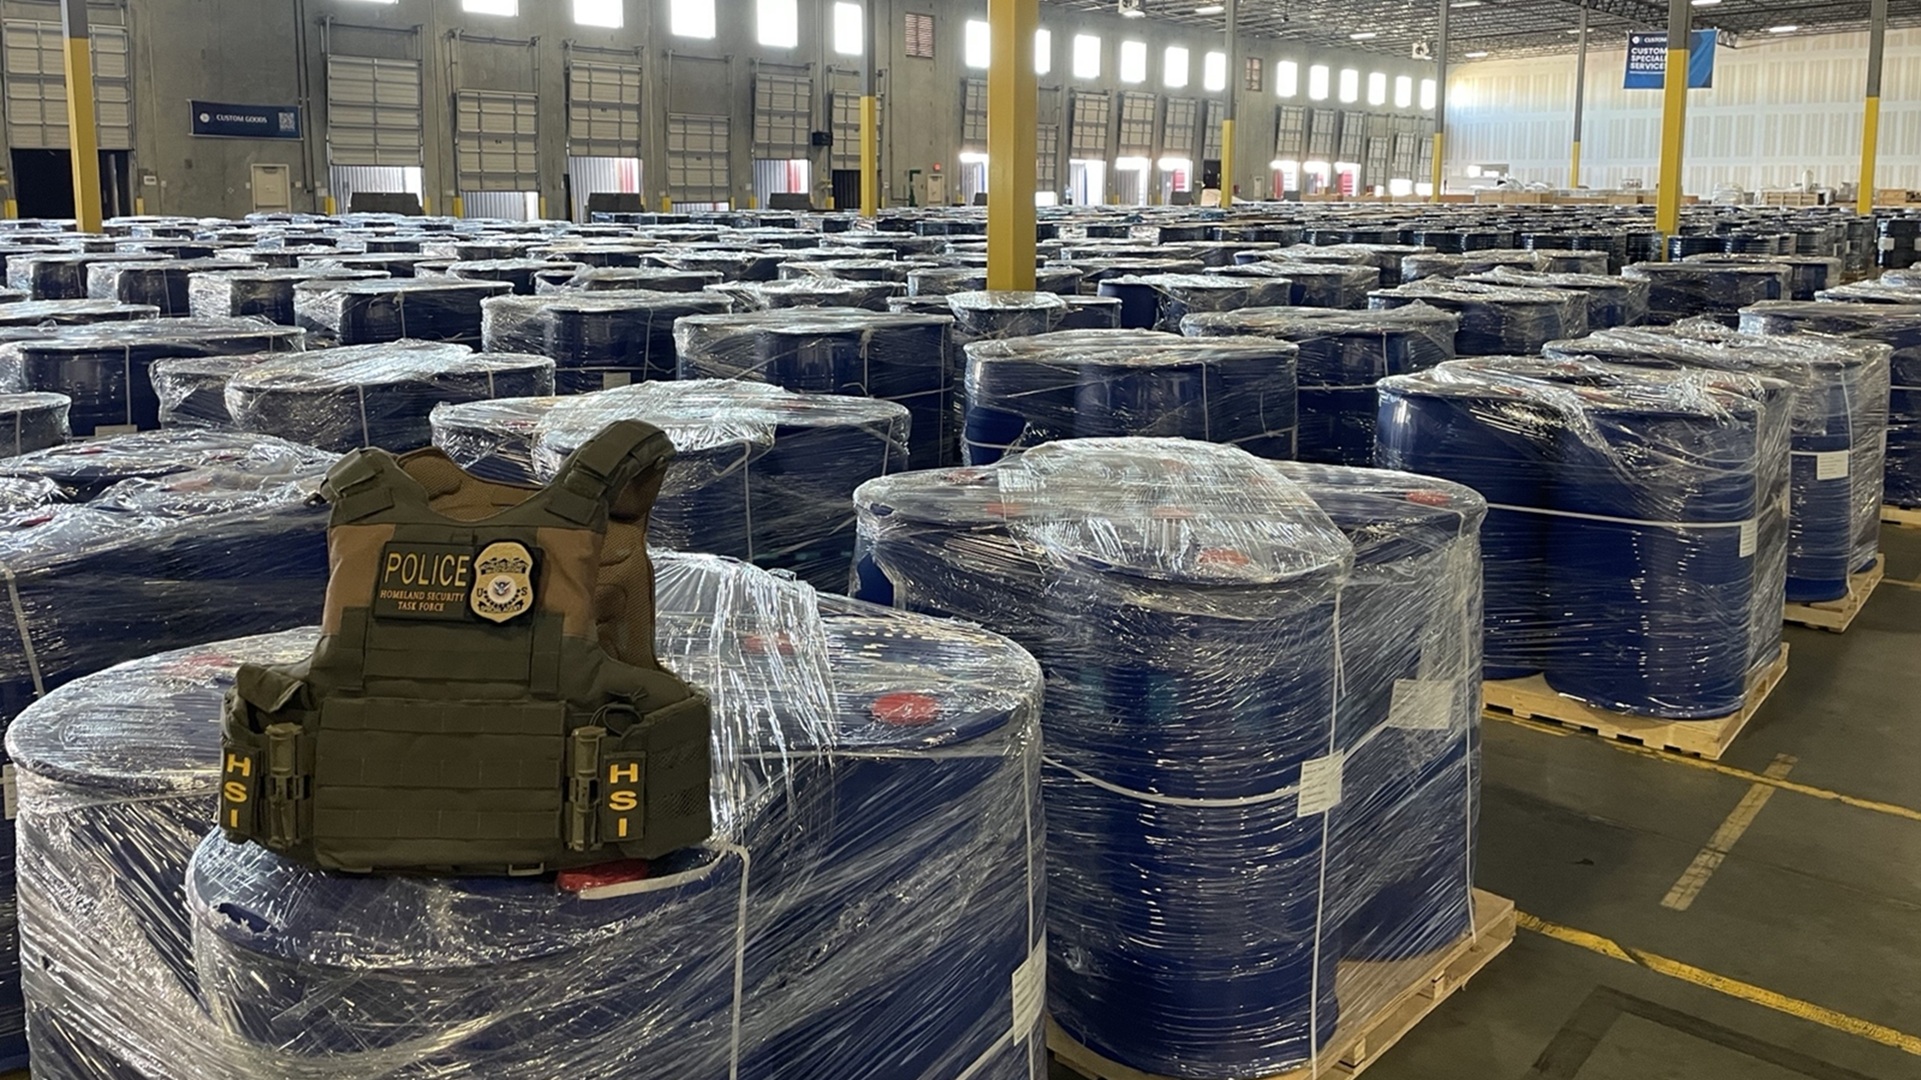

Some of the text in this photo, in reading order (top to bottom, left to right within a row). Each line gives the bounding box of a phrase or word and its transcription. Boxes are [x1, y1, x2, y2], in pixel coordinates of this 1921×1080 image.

[1630, 62, 1664, 70] SERVICE
[216, 114, 244, 122] CUSTOM
[384, 553, 470, 587] POLICE
[380, 590, 465, 602] HOMELAND SECURITY
[476, 586, 528, 598] U S
[398, 601, 444, 612] TASK FORCE
[224, 754, 251, 828] HSI
[609, 763, 638, 837] HSI
